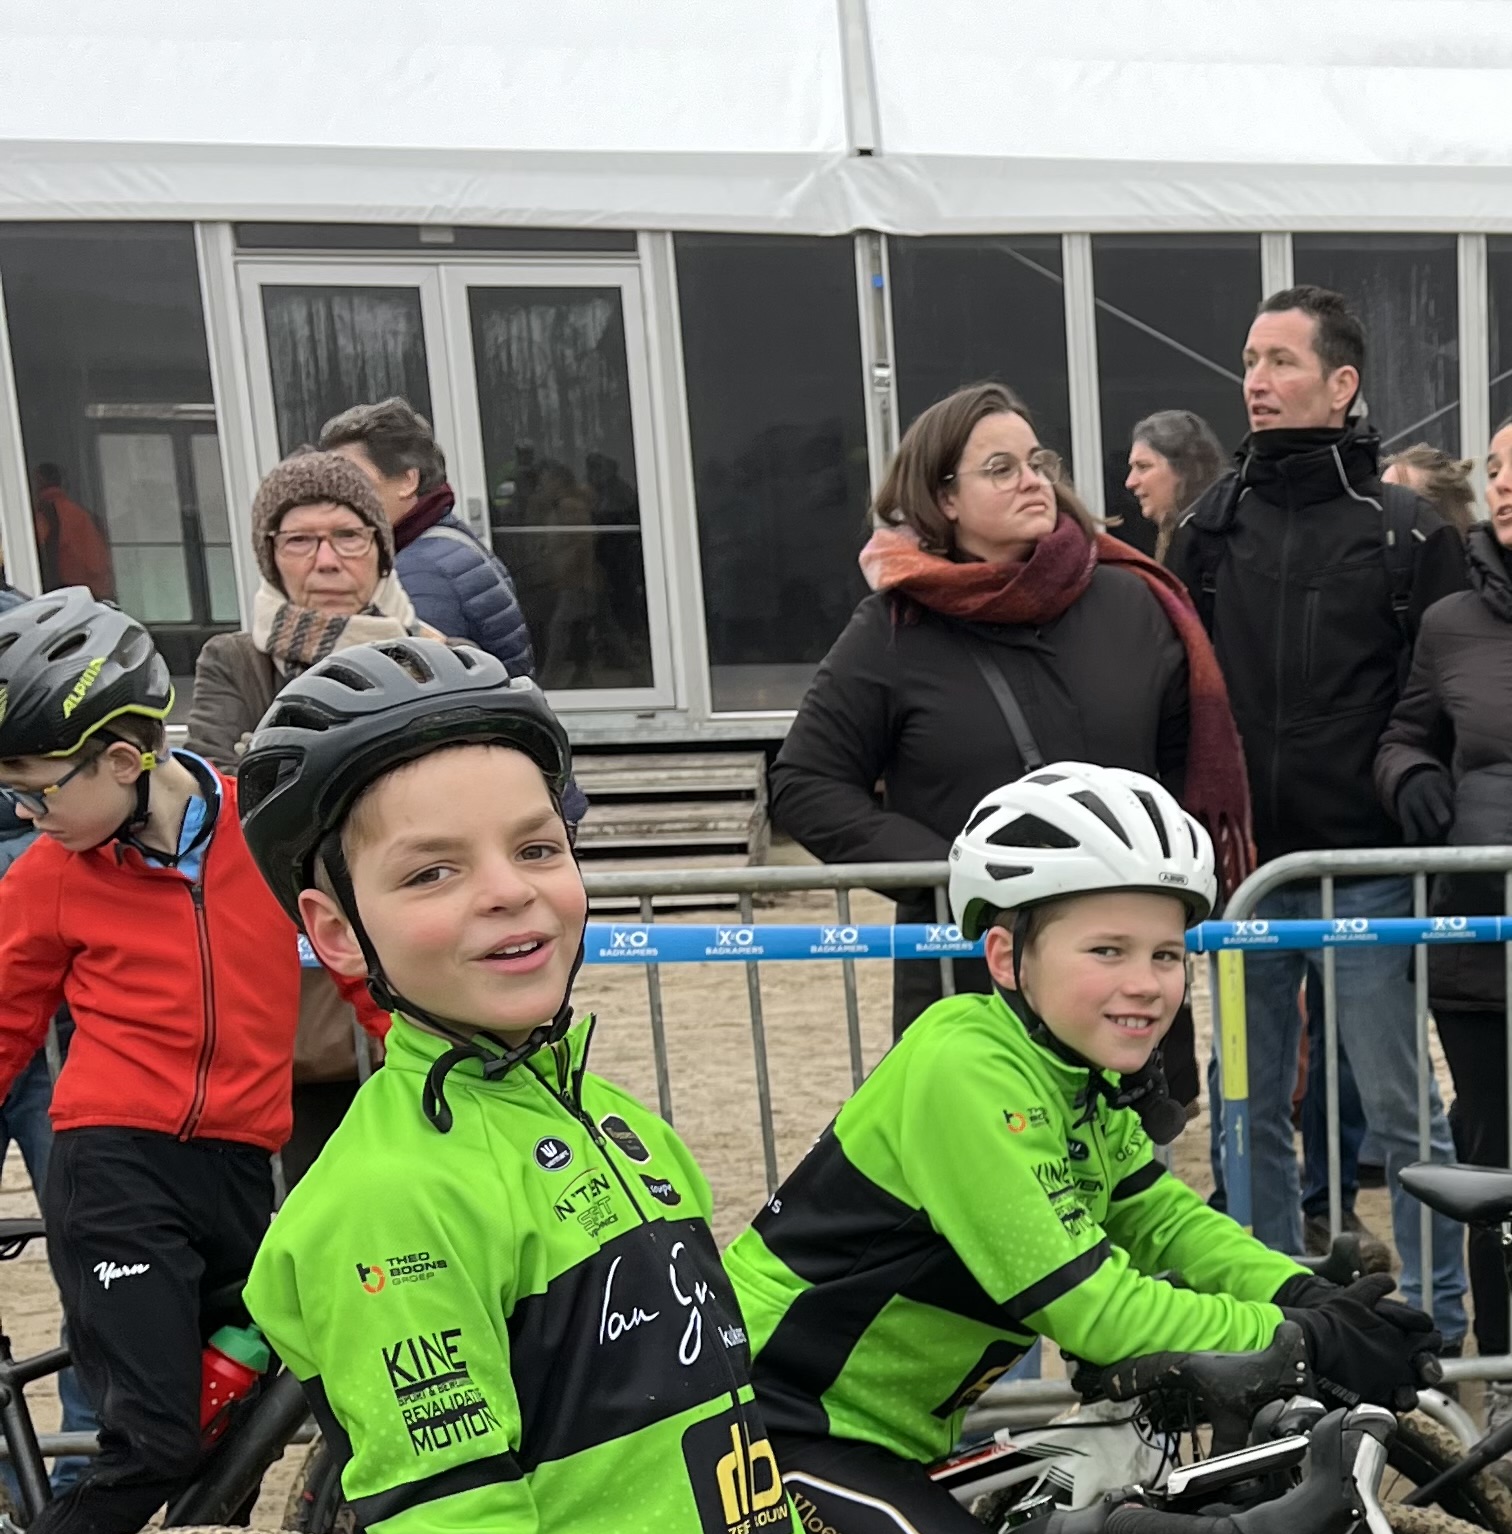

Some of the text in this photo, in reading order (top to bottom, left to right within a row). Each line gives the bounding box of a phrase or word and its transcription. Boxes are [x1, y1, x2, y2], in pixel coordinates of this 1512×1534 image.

[63, 656, 108, 719] ALPINA
[386, 1251, 430, 1266] THEO
[389, 1259, 448, 1277] BOONS
[391, 1271, 435, 1285] GROEP
[381, 1328, 467, 1388] KINE
[408, 1407, 503, 1457] MOTION
